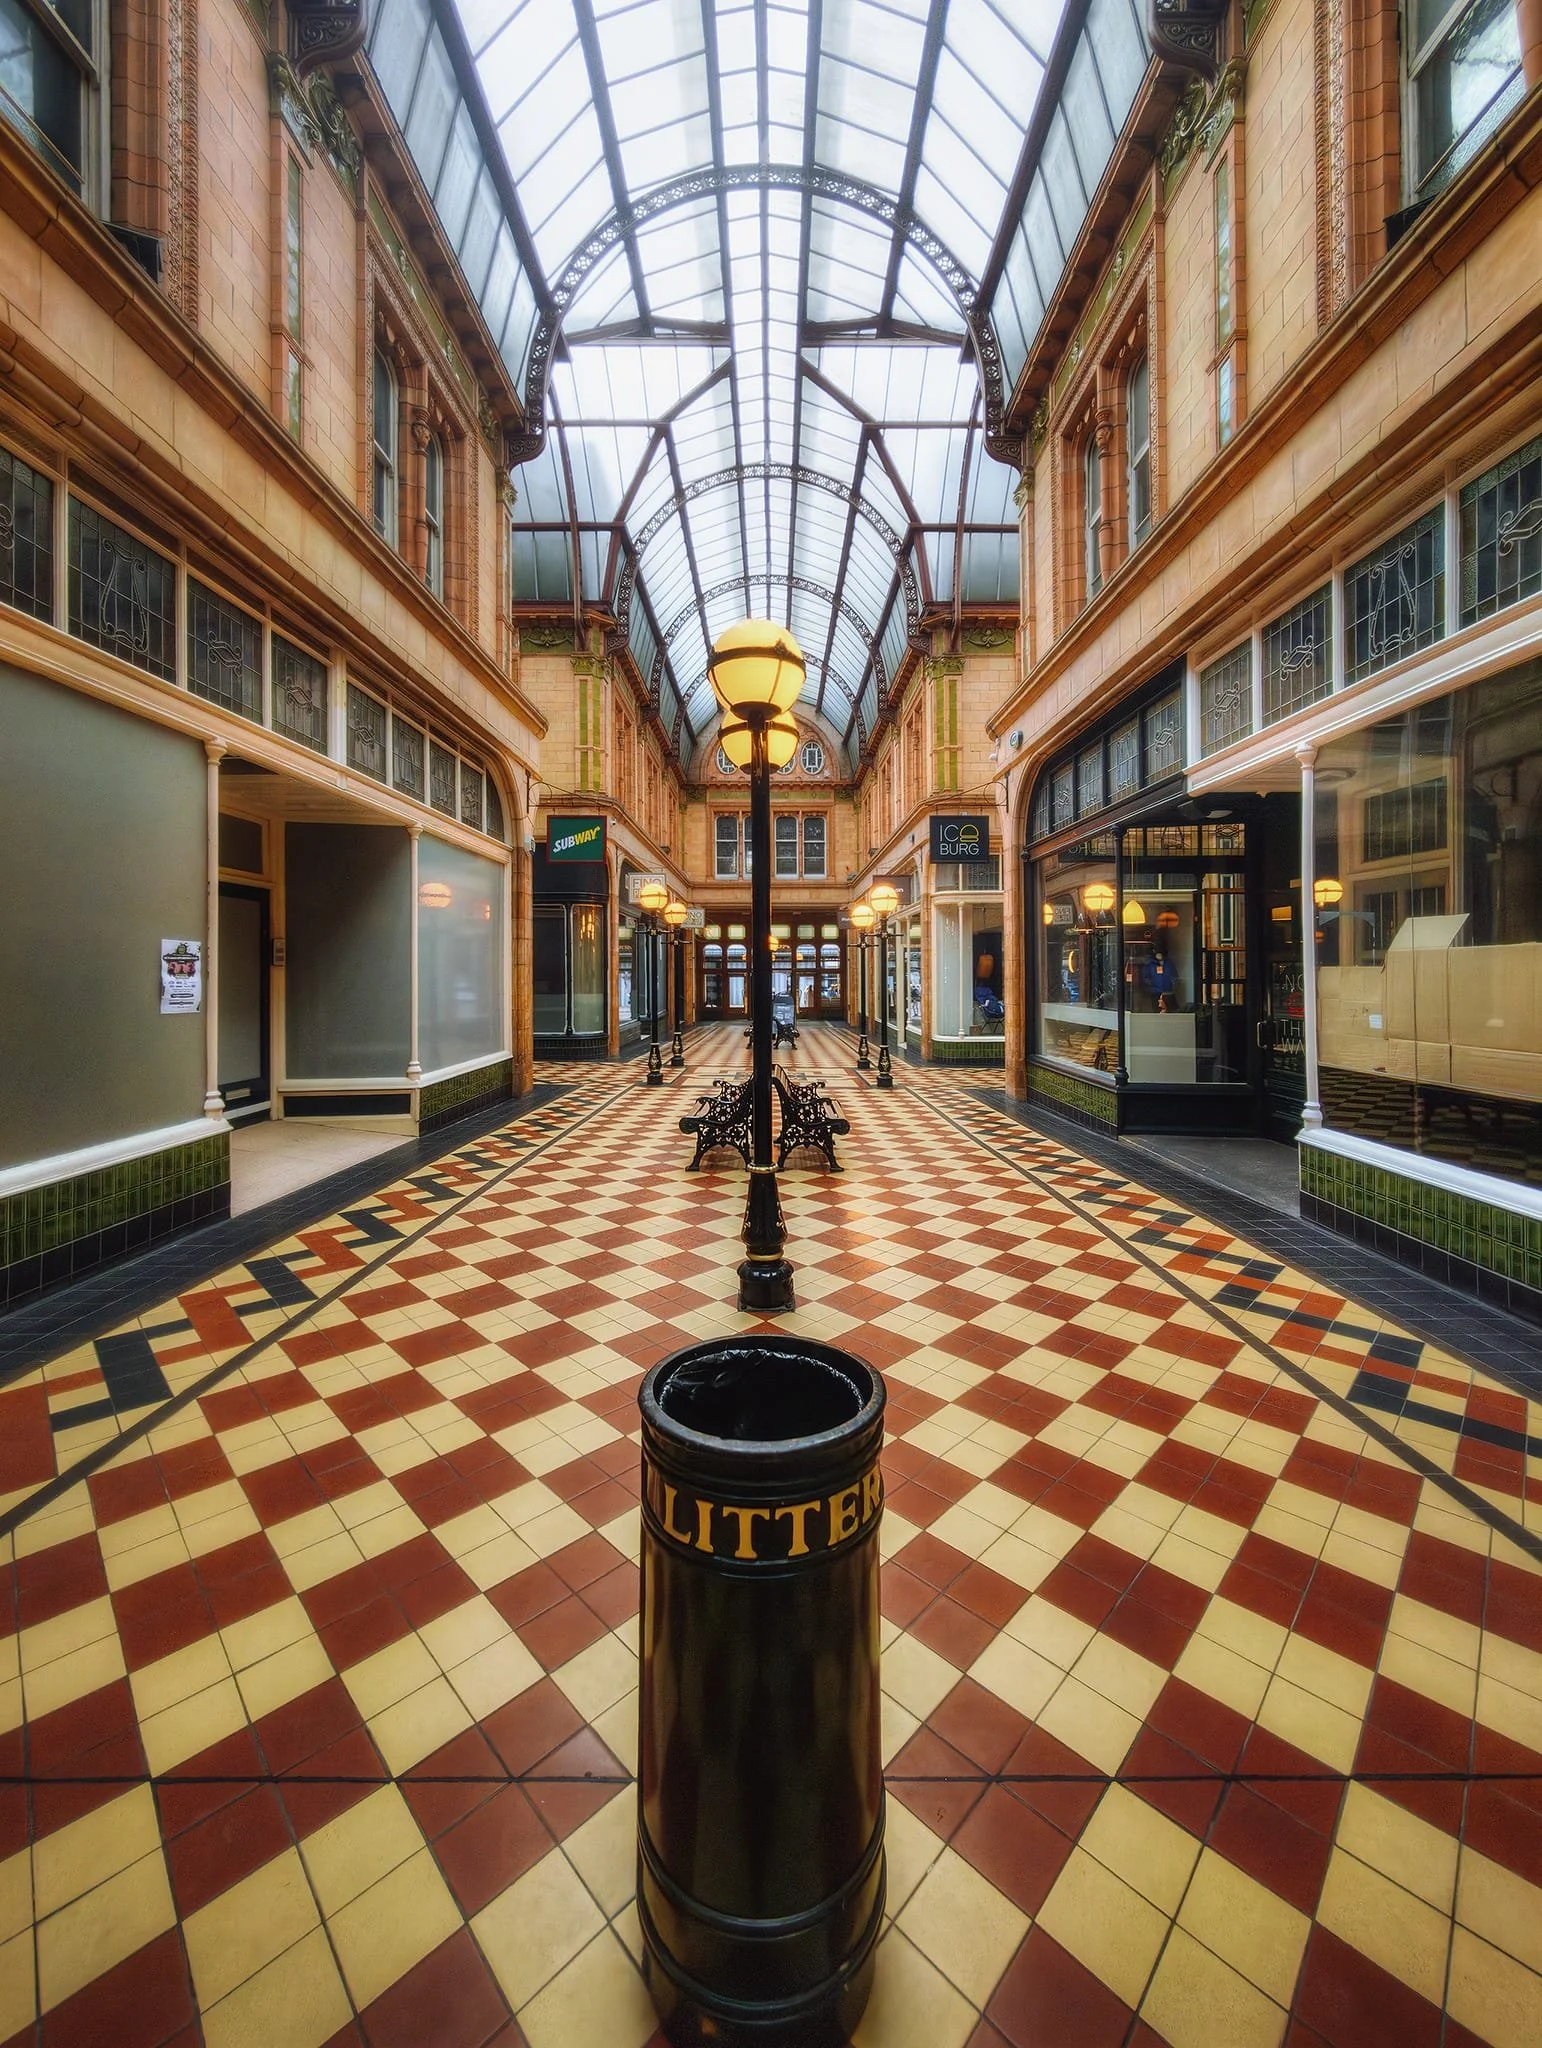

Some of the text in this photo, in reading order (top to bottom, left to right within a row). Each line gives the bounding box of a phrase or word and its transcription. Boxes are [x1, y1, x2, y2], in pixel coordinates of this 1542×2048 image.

[553, 826, 600, 853] SUBWAY
[940, 843, 980, 856] BURG
[1281, 1038, 1305, 1055] WA
[663, 1464, 881, 1559] LITTER
